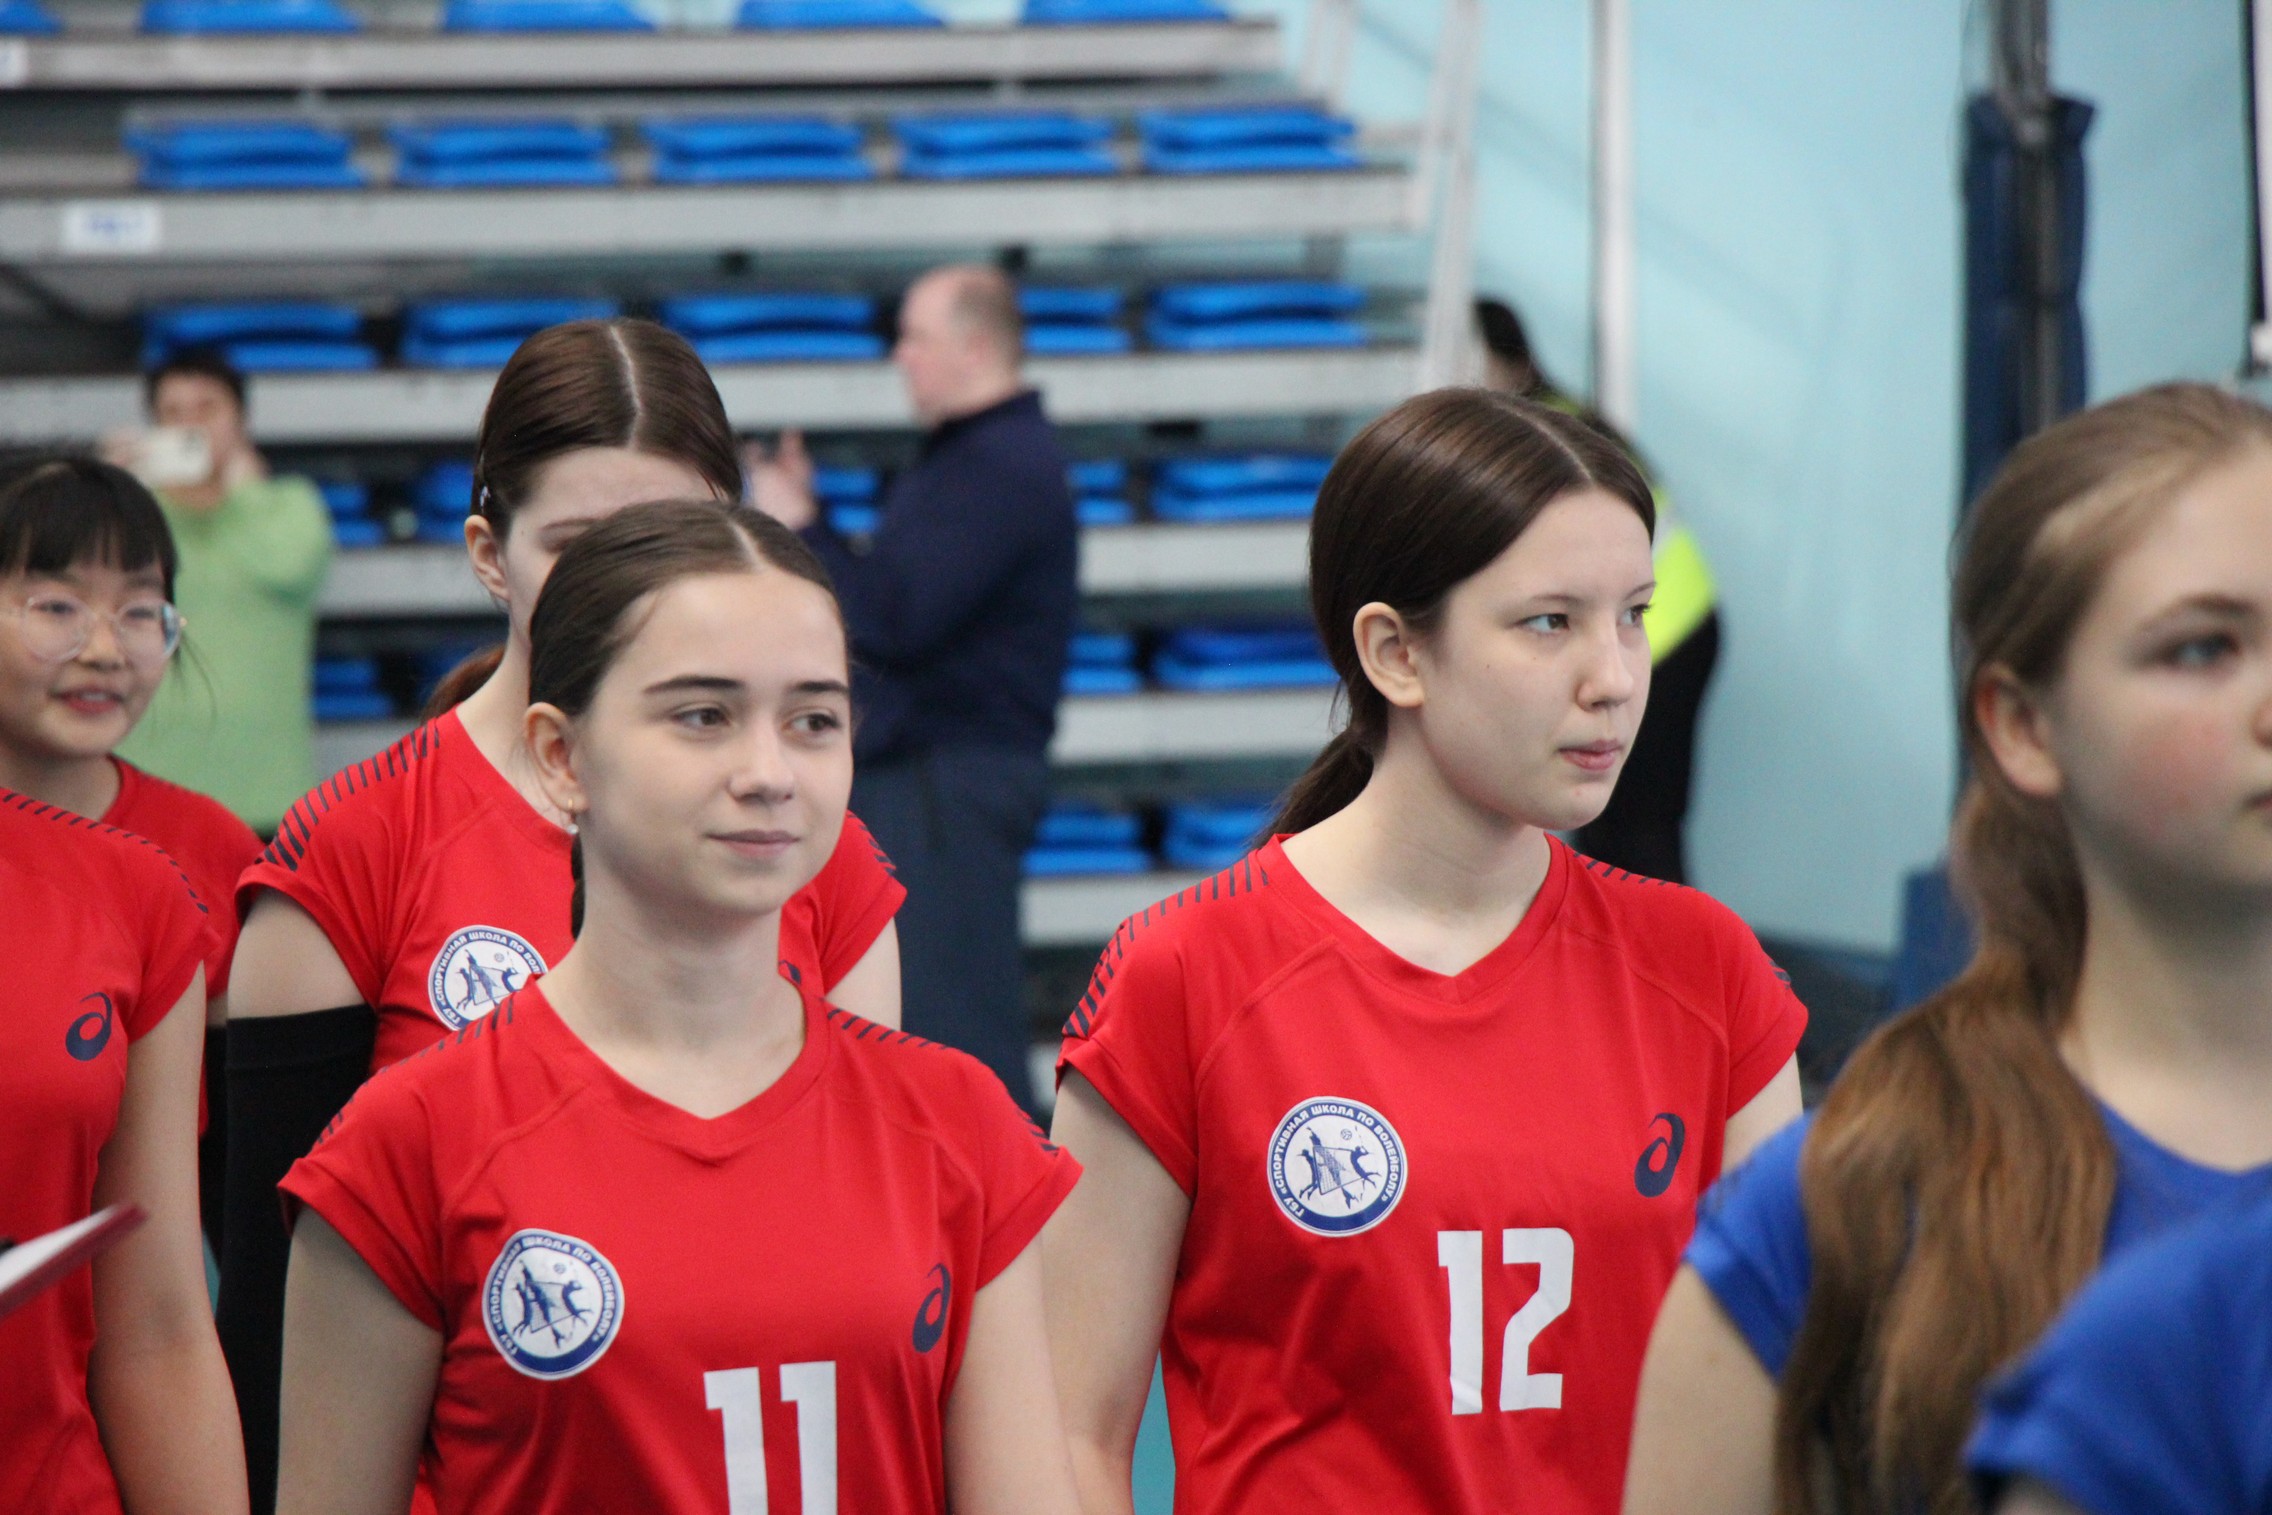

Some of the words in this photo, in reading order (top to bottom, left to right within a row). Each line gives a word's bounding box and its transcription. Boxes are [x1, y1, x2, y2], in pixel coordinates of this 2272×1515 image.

[443, 1008, 461, 1024] ГБУ
[468, 931, 507, 944] ШКОЛА
[509, 940, 525, 953] ПО
[1311, 1104, 1355, 1118] ШКОЛА
[1356, 1111, 1374, 1126] ПО
[1273, 1110, 1310, 1194] «СПОРТИВНАЯ
[1374, 1126, 1399, 1202] ВОЛЕЙБОЛУ»
[1284, 1198, 1304, 1217] ГБУ
[522, 1236, 572, 1253] ШКОЛА
[573, 1247, 592, 1262] ПО
[1437, 1227, 1574, 1415] 12
[703, 1361, 838, 1515] 11
